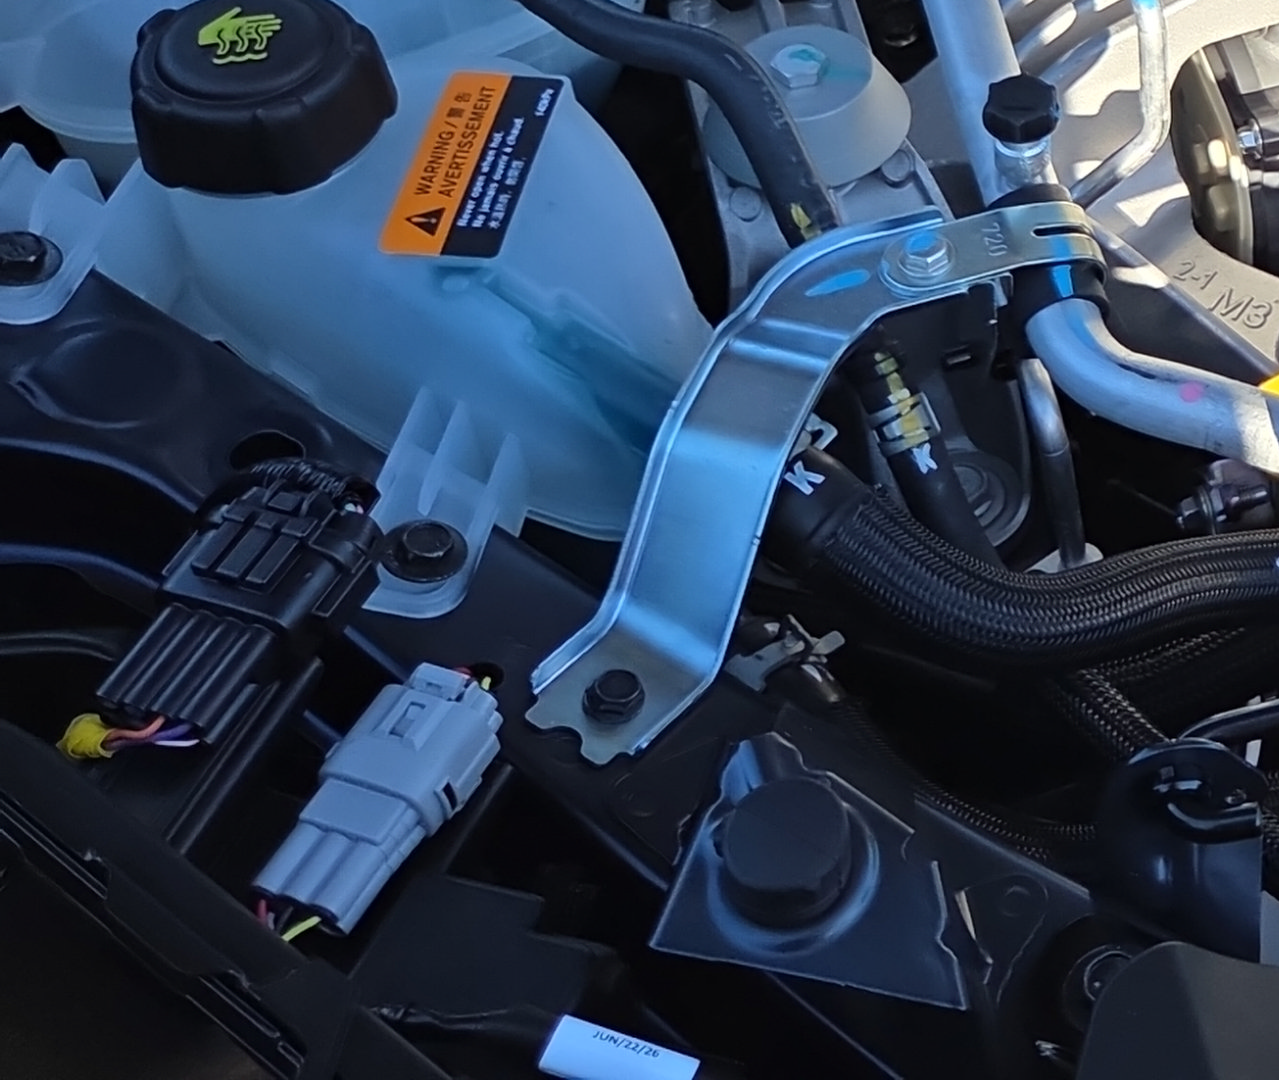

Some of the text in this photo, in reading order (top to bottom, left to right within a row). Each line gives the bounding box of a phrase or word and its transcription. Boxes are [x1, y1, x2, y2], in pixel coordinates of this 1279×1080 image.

[439, 86, 497, 197] AVERTISSEMENT
[413, 130, 456, 195] WARNING
[478, 149, 497, 172] when
[469, 175, 488, 197] open
[478, 182, 501, 212] jamais
[455, 200, 477, 226] Never
[982, 221, 1008, 258] 720
[1172, 259, 1274, 329] 2-1 M3
[784, 460, 826, 495] K
